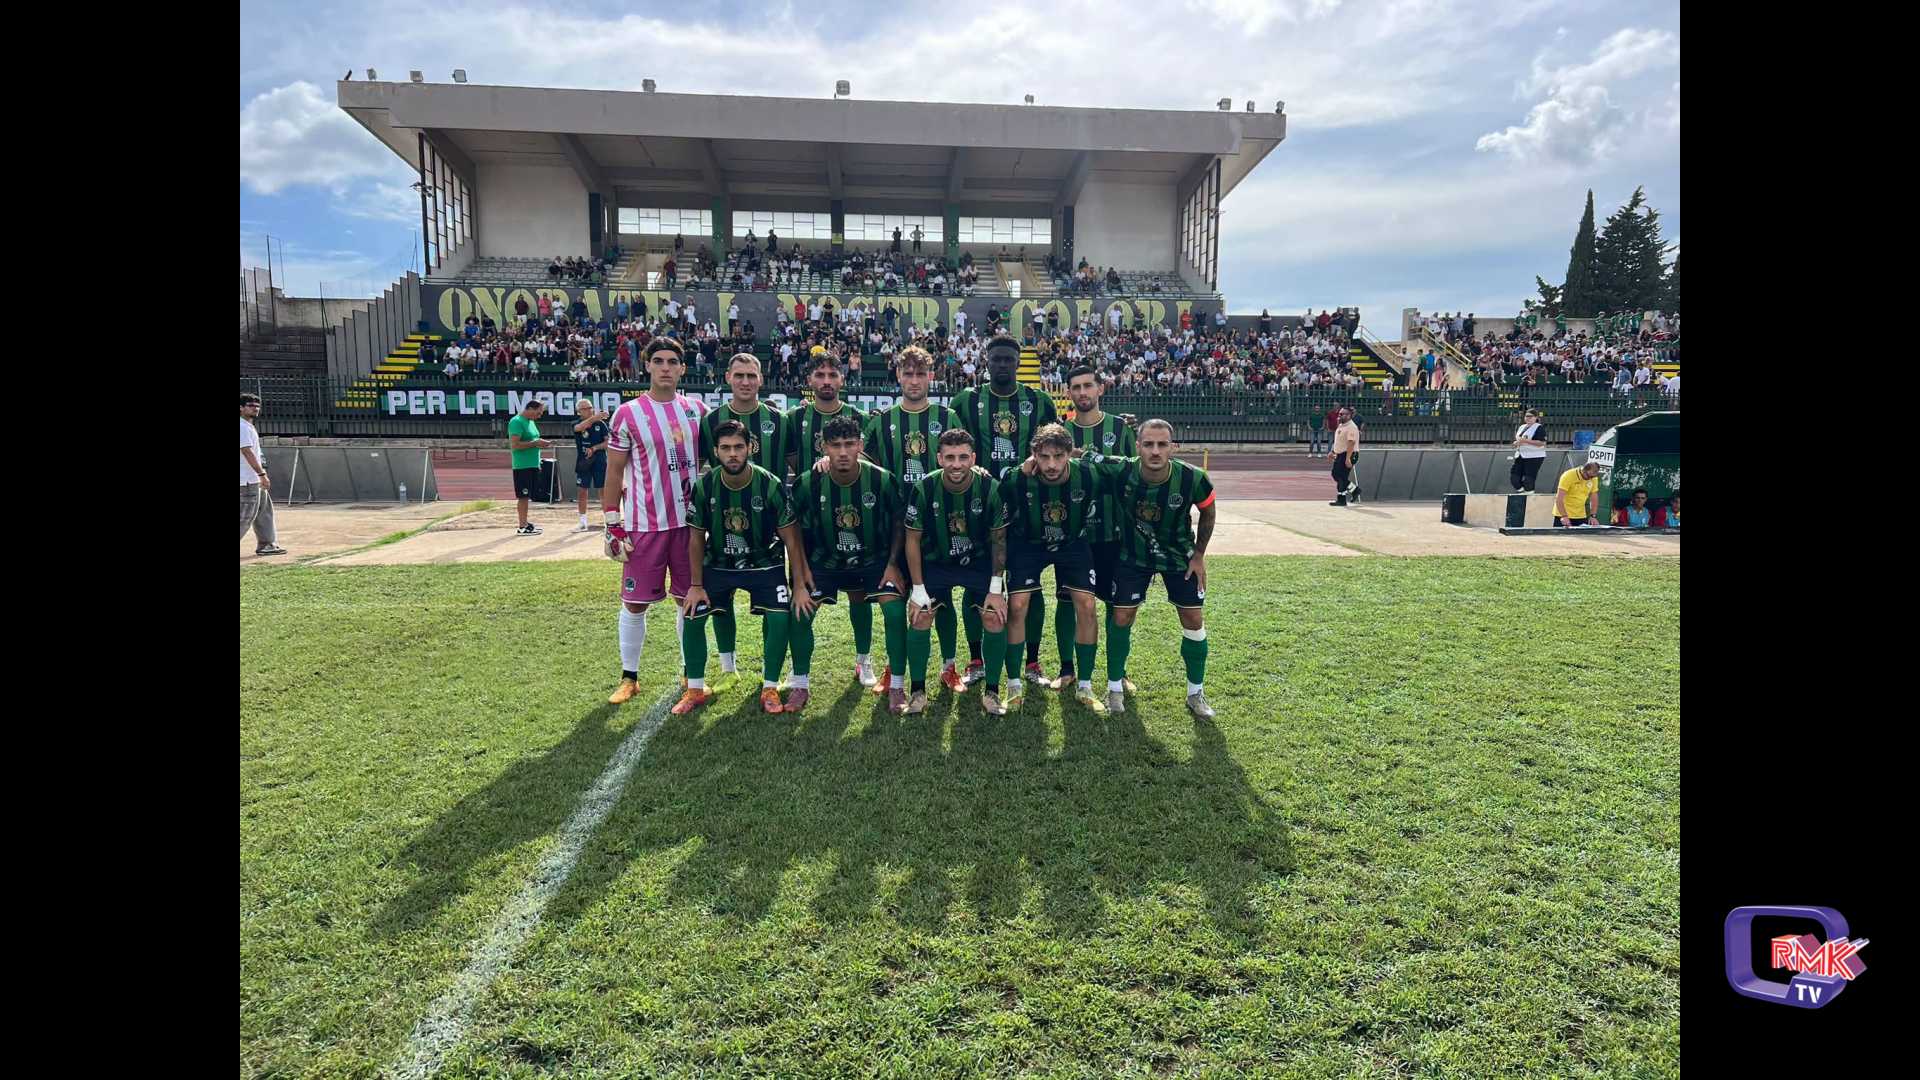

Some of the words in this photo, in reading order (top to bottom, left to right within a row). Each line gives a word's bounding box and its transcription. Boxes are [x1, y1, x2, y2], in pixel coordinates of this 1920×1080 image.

[387, 390, 446, 415] PER
[457, 391, 496, 415] LA
[1590, 450, 1613, 461] OSPITI
[776, 584, 789, 603] 2
